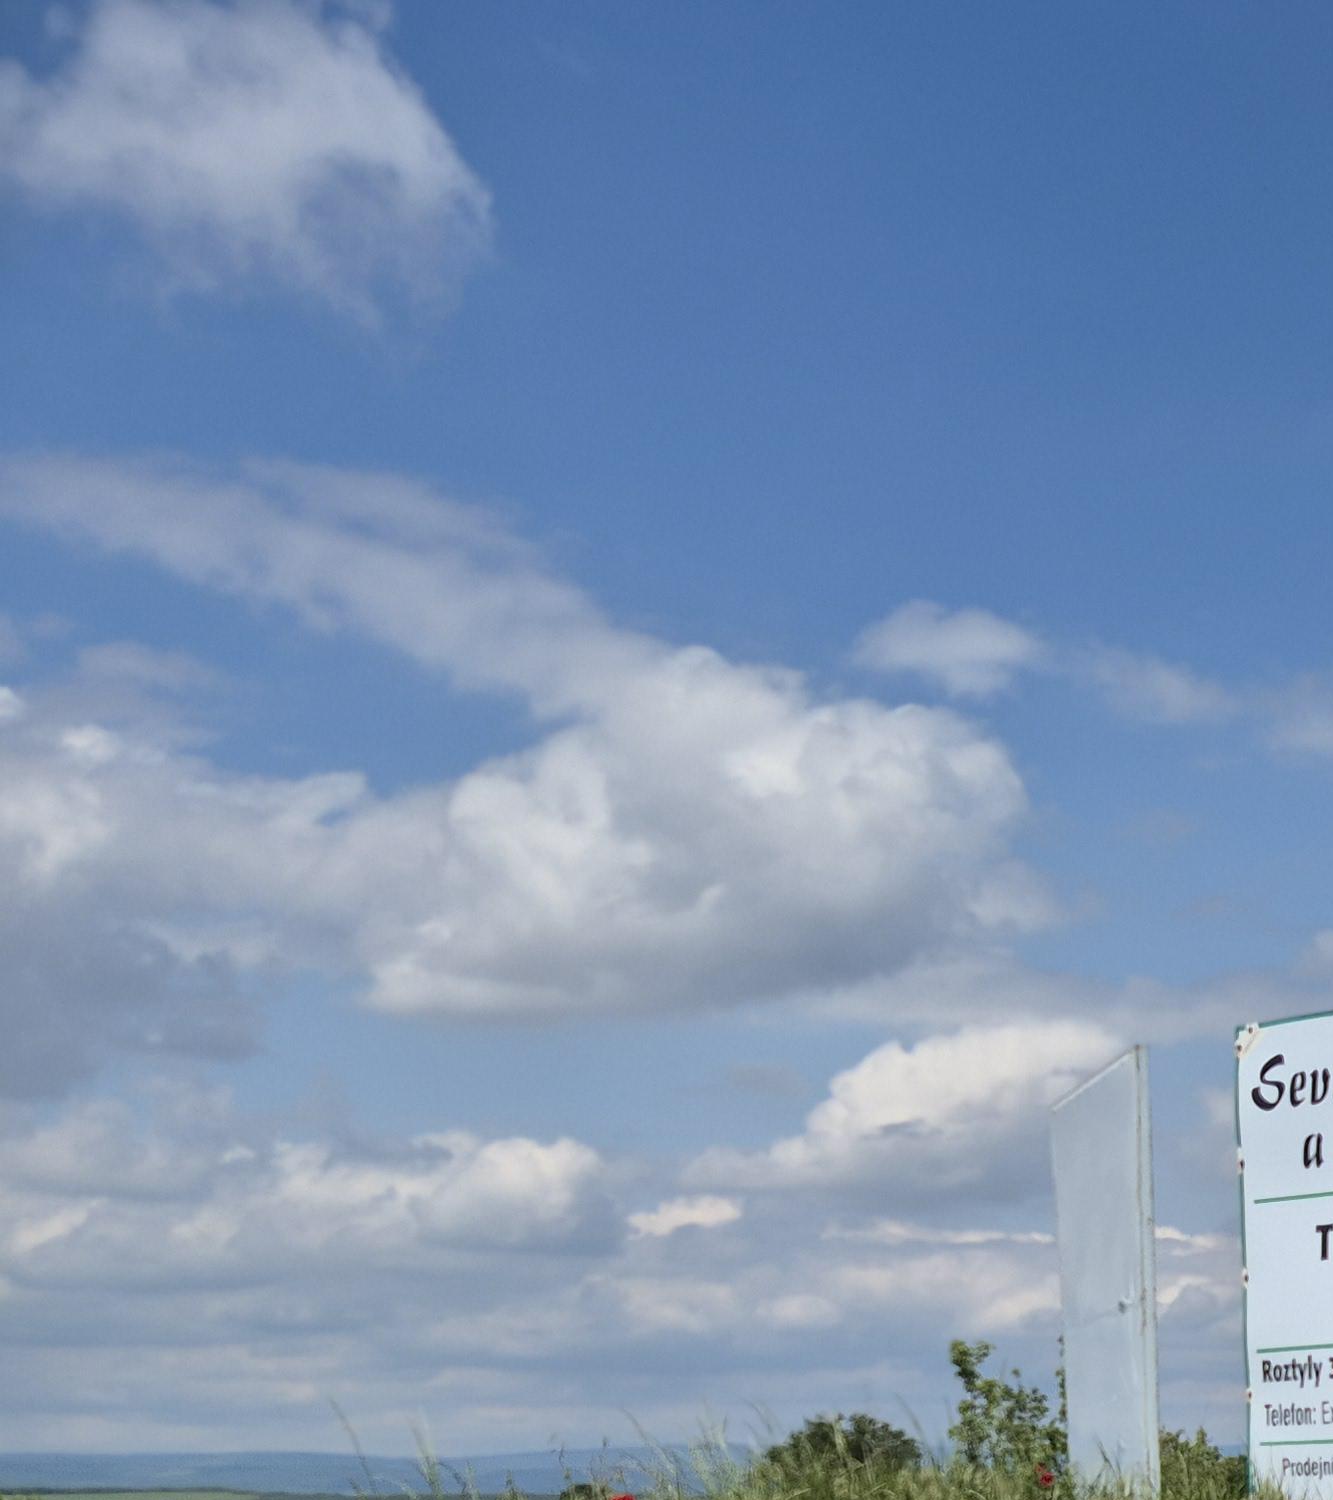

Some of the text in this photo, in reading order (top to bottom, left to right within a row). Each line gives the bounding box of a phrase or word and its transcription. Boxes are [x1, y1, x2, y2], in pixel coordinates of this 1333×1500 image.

[1303, 1133, 1323, 1168] a
[1262, 1355, 1322, 1388] Roztyly
[1264, 1402, 1316, 1426] Telefon:
[1282, 1457, 1333, 1480] Prodejní
